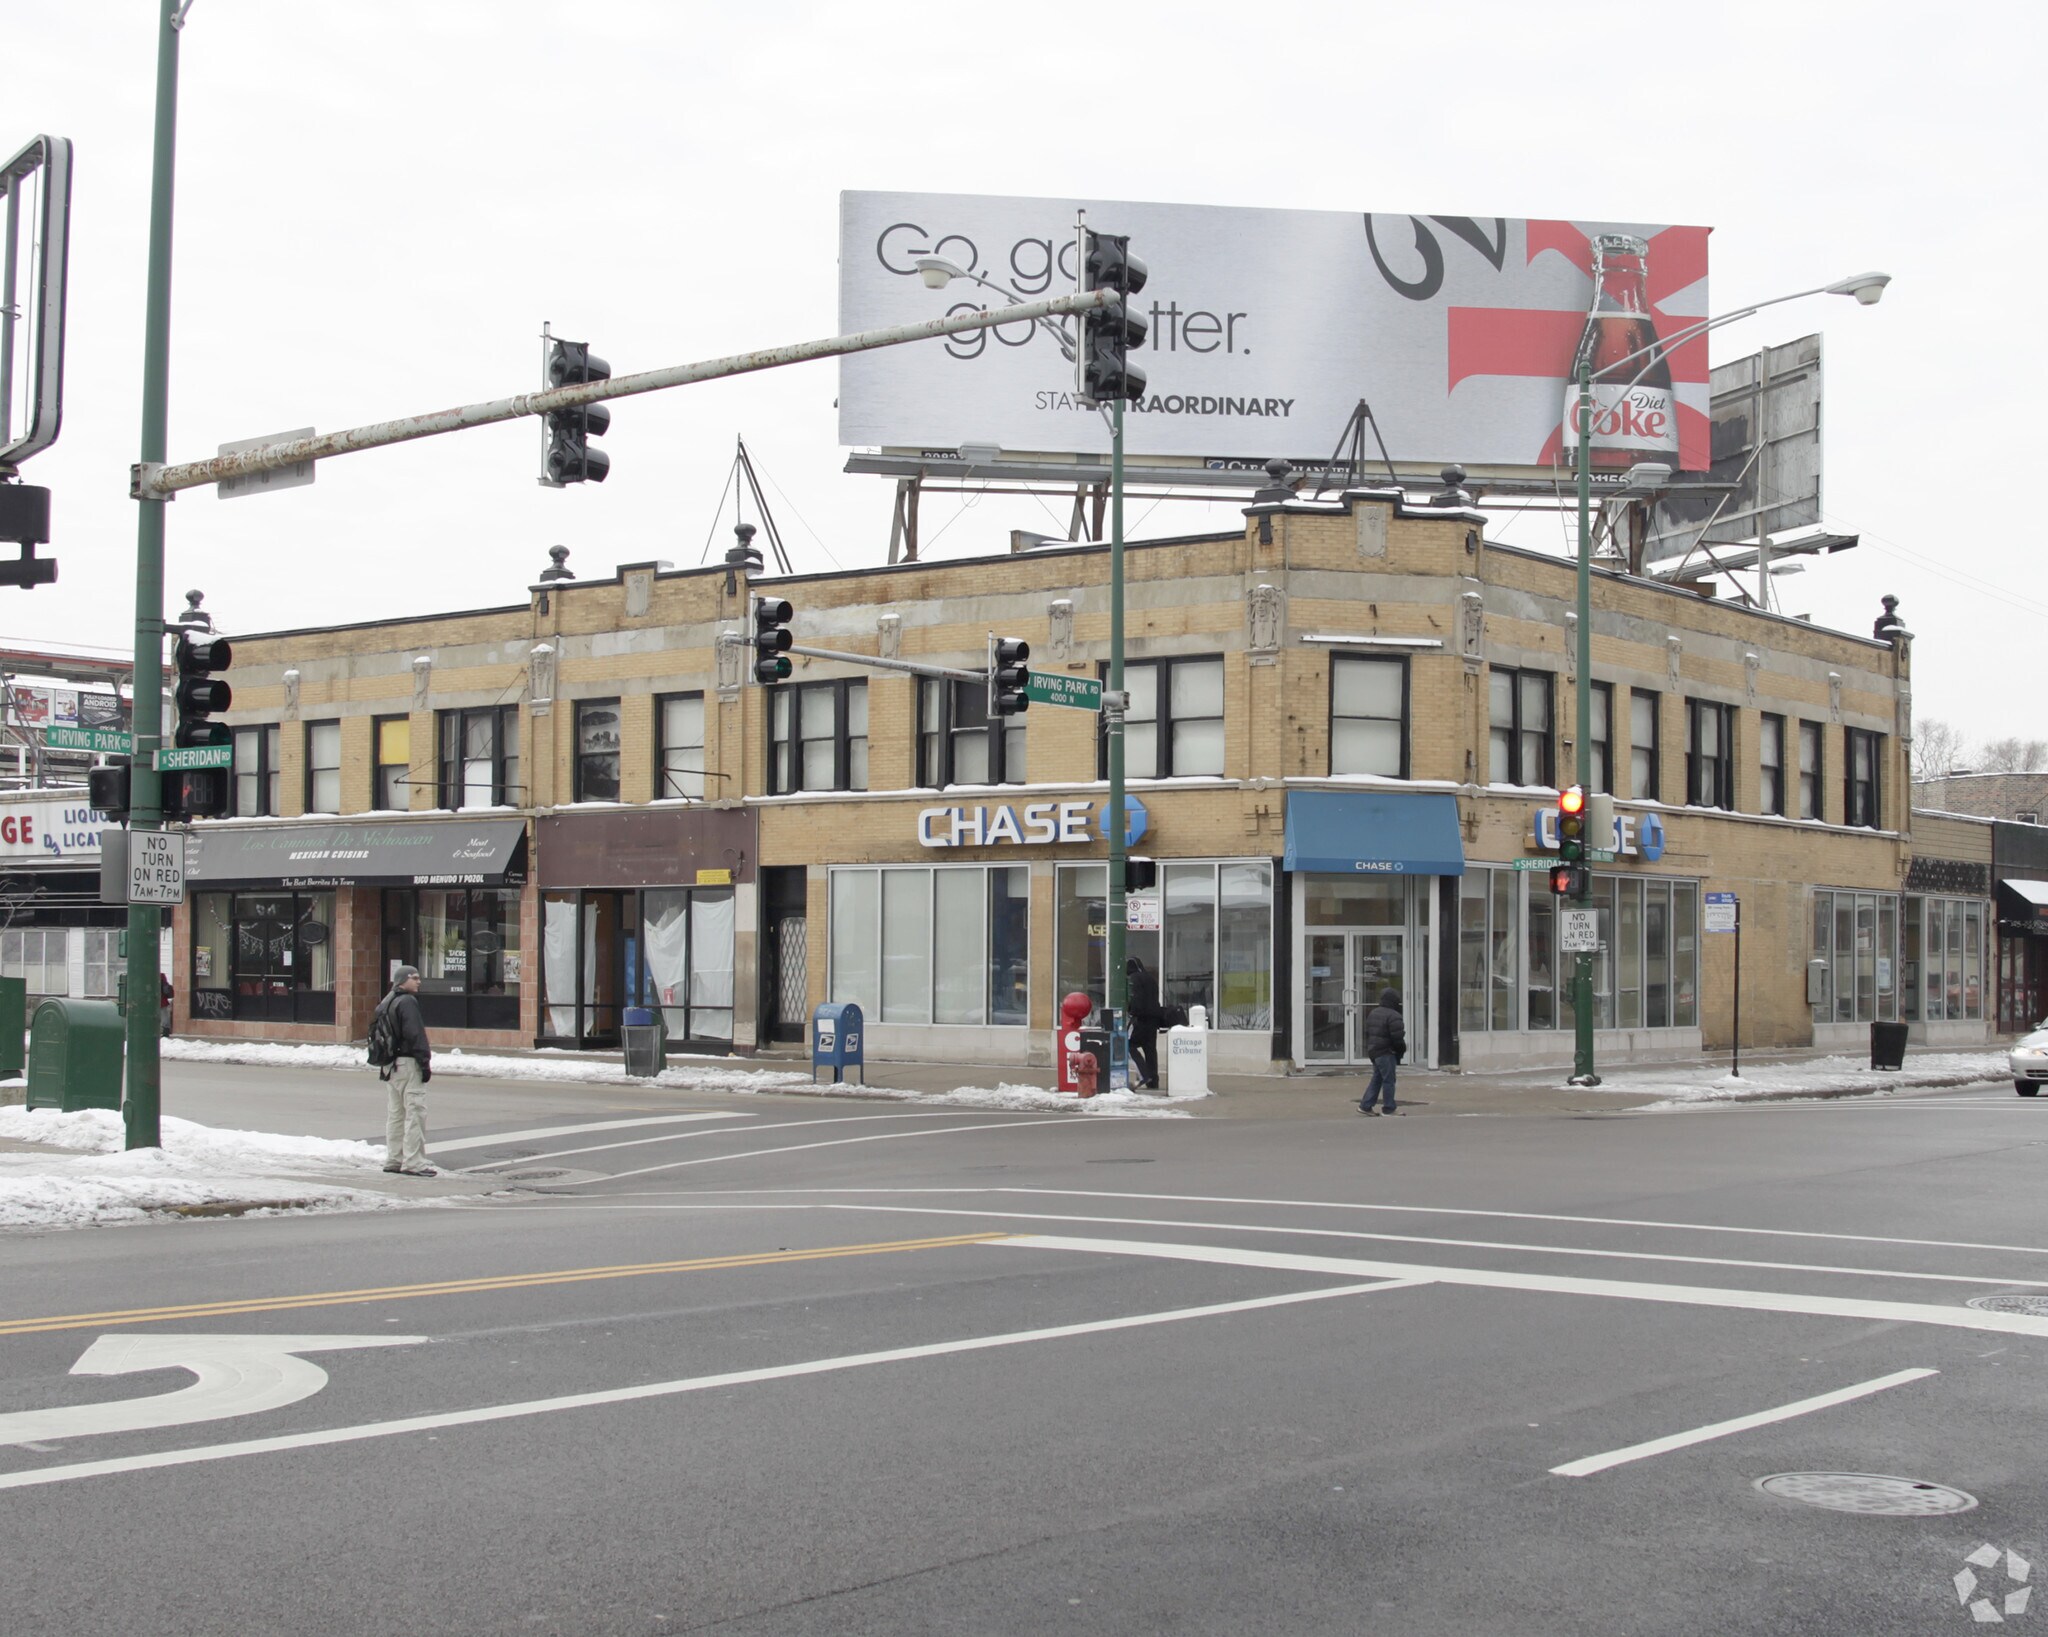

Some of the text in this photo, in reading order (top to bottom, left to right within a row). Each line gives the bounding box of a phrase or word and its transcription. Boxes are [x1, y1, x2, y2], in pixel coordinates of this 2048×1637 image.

[877, 223, 989, 288] Go,
[943, 302, 1036, 361] go
[1085, 394, 1296, 417] RAORDINARY
[1630, 392, 1666, 410] Diet
[1570, 399, 1666, 438] Coke
[1033, 676, 1062, 691] IRVING
[1065, 680, 1088, 695] PARK
[1090, 685, 1099, 695] RD
[83, 699, 117, 708] ANDROID
[1050, 693, 1067, 703] 4000
[58, 729, 91, 747] IRVING
[94, 733, 122, 751] PARK
[121, 739, 131, 748] RD
[168, 750, 221, 767] SHERIDAN
[221, 752, 231, 761] RD
[64, 808, 109, 824] LIQUO
[1, 816, 34, 844] GE
[917, 801, 1095, 848] CHASE
[147, 837, 168, 850] NO
[466, 838, 489, 847] Meat
[141, 852, 174, 867] TURN
[288, 850, 370, 860] MEXICAN CUISINE
[461, 847, 497, 860] Seafood
[1355, 861, 1393, 871] CHASE
[134, 868, 180, 883] ON RED
[281, 877, 355, 887] The Best Burritos In Town
[413, 874, 485, 884] RICO MENUDO Y POZOL
[133, 884, 180, 899] 7AM-7PM
[1572, 913, 1586, 921] NO
[1568, 922, 1590, 930] TURN
[1578, 931, 1595, 939] RED
[1172, 1037, 1202, 1047] Chicago
[1172, 1046, 1202, 1055] Tribune
